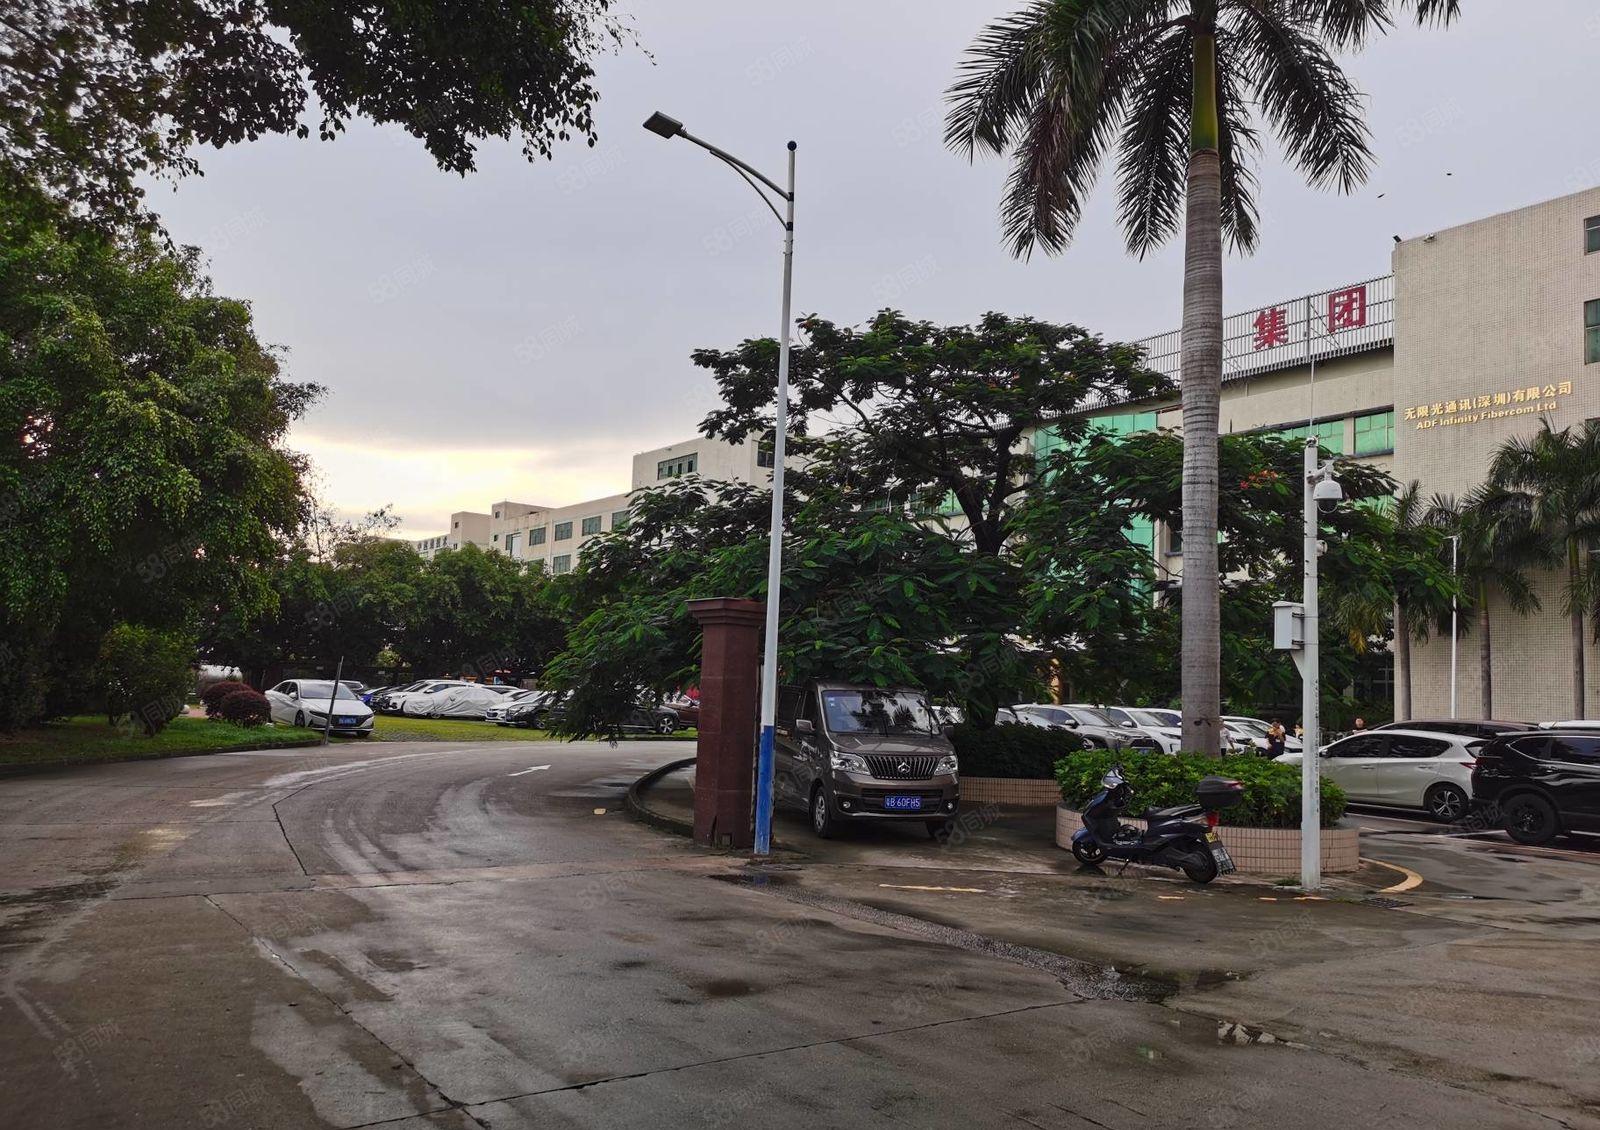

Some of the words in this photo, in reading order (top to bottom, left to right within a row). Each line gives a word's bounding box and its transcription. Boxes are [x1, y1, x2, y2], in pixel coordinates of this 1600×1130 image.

[1404, 381, 1573, 421] 无限光通讯(深圳)有限公司
[1416, 419, 1438, 430] ADF
[1439, 413, 1478, 426] Infinity
[1481, 407, 1534, 420] Fibercom
[1537, 401, 1557, 412] Ltd
